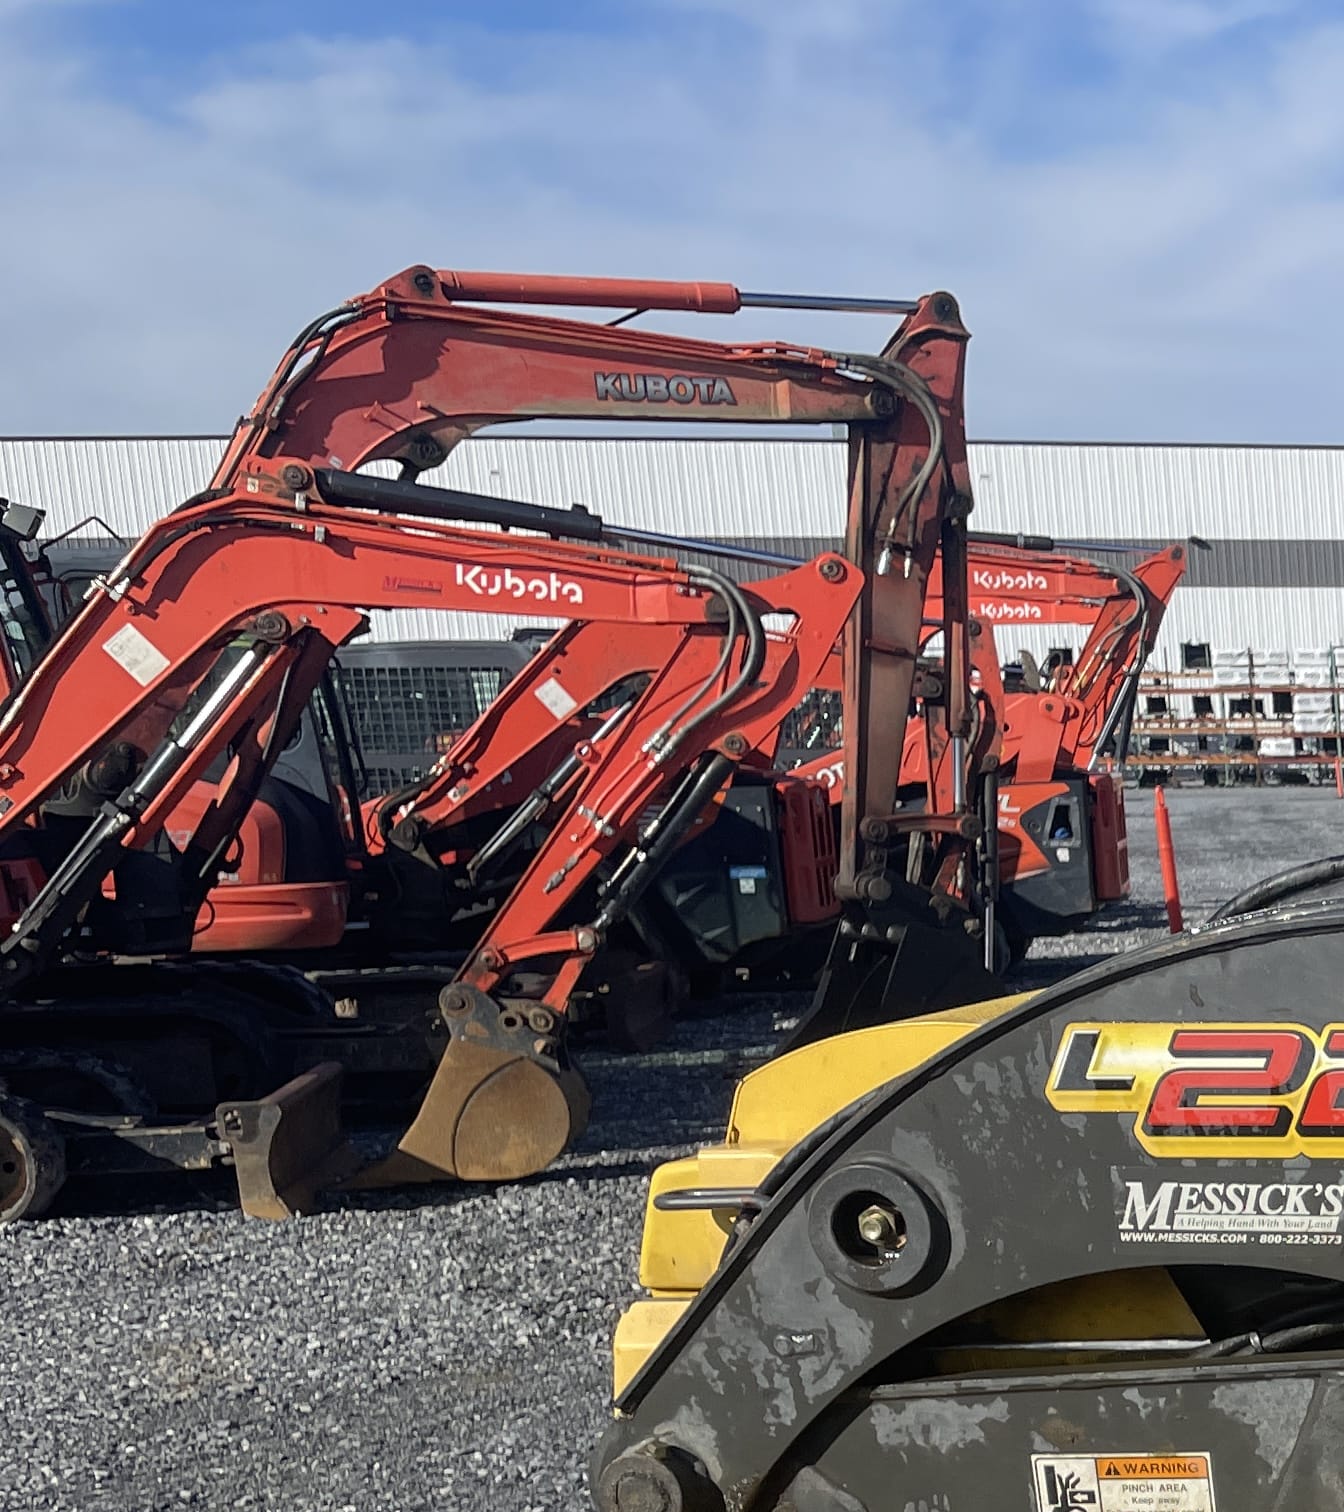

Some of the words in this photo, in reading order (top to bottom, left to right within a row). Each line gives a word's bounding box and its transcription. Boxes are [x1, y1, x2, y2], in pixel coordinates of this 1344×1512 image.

[594, 372, 738, 406] KUBOTA
[455, 563, 583, 603] Kubota
[973, 570, 1048, 590] Kubota
[980, 602, 1042, 619] Kubota
[1178, 1218, 1184, 1227] A
[1187, 1217, 1224, 1230] Helping
[1227, 1218, 1254, 1228] Hand
[1258, 1218, 1280, 1229] With
[1283, 1219, 1305, 1229] Your
[1307, 1219, 1333, 1231] Land
[1120, 1231, 1247, 1244] WWW.MESSICKS.COM
[1259, 1233, 1342, 1245] 800-222-3373
[1123, 1462, 1199, 1474] WARNING
[1122, 1483, 1153, 1493] PINCH
[1159, 1483, 1188, 1493] AREA
[1131, 1496, 1154, 1505] Keep
